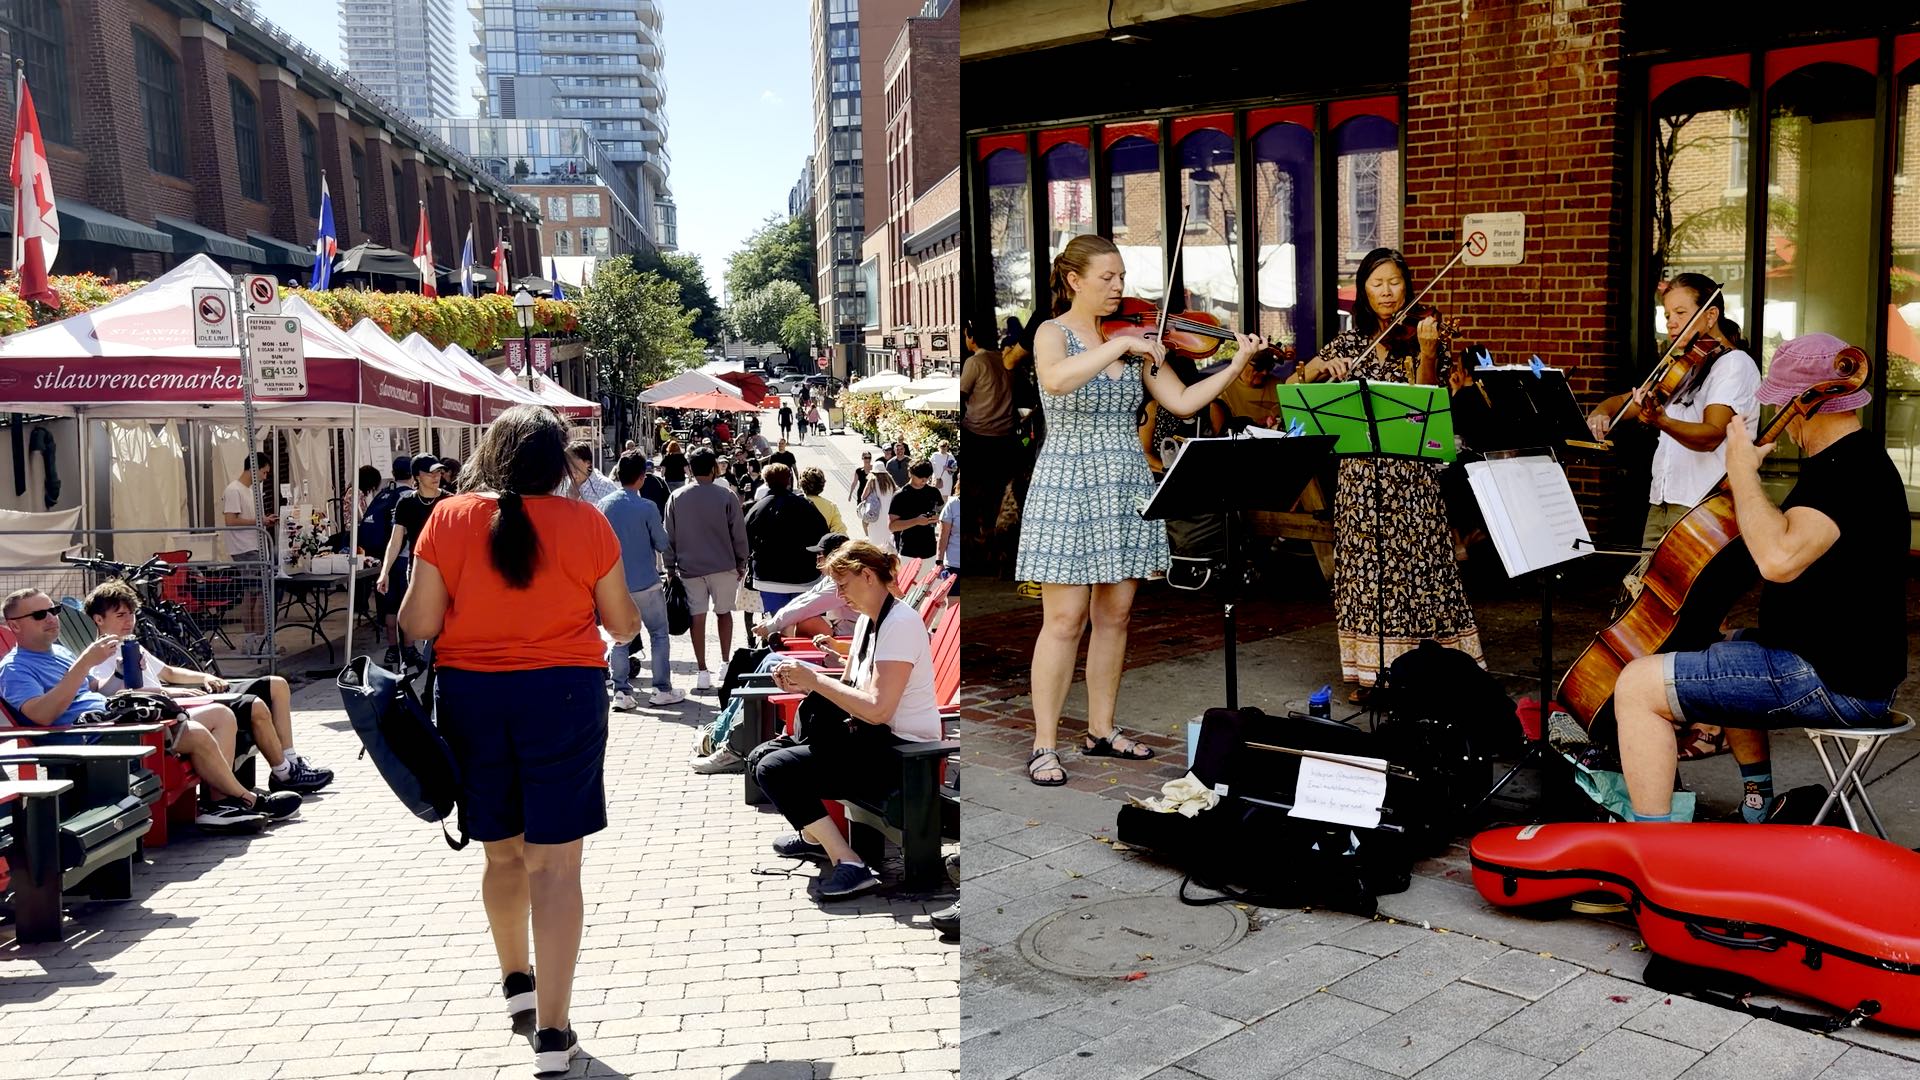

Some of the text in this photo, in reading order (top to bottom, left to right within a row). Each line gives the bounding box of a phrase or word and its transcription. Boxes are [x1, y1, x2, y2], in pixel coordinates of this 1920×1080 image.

[1493, 229, 1512, 237] Please
[1502, 239, 1515, 247] feed
[274, 366, 298, 375] 4130
